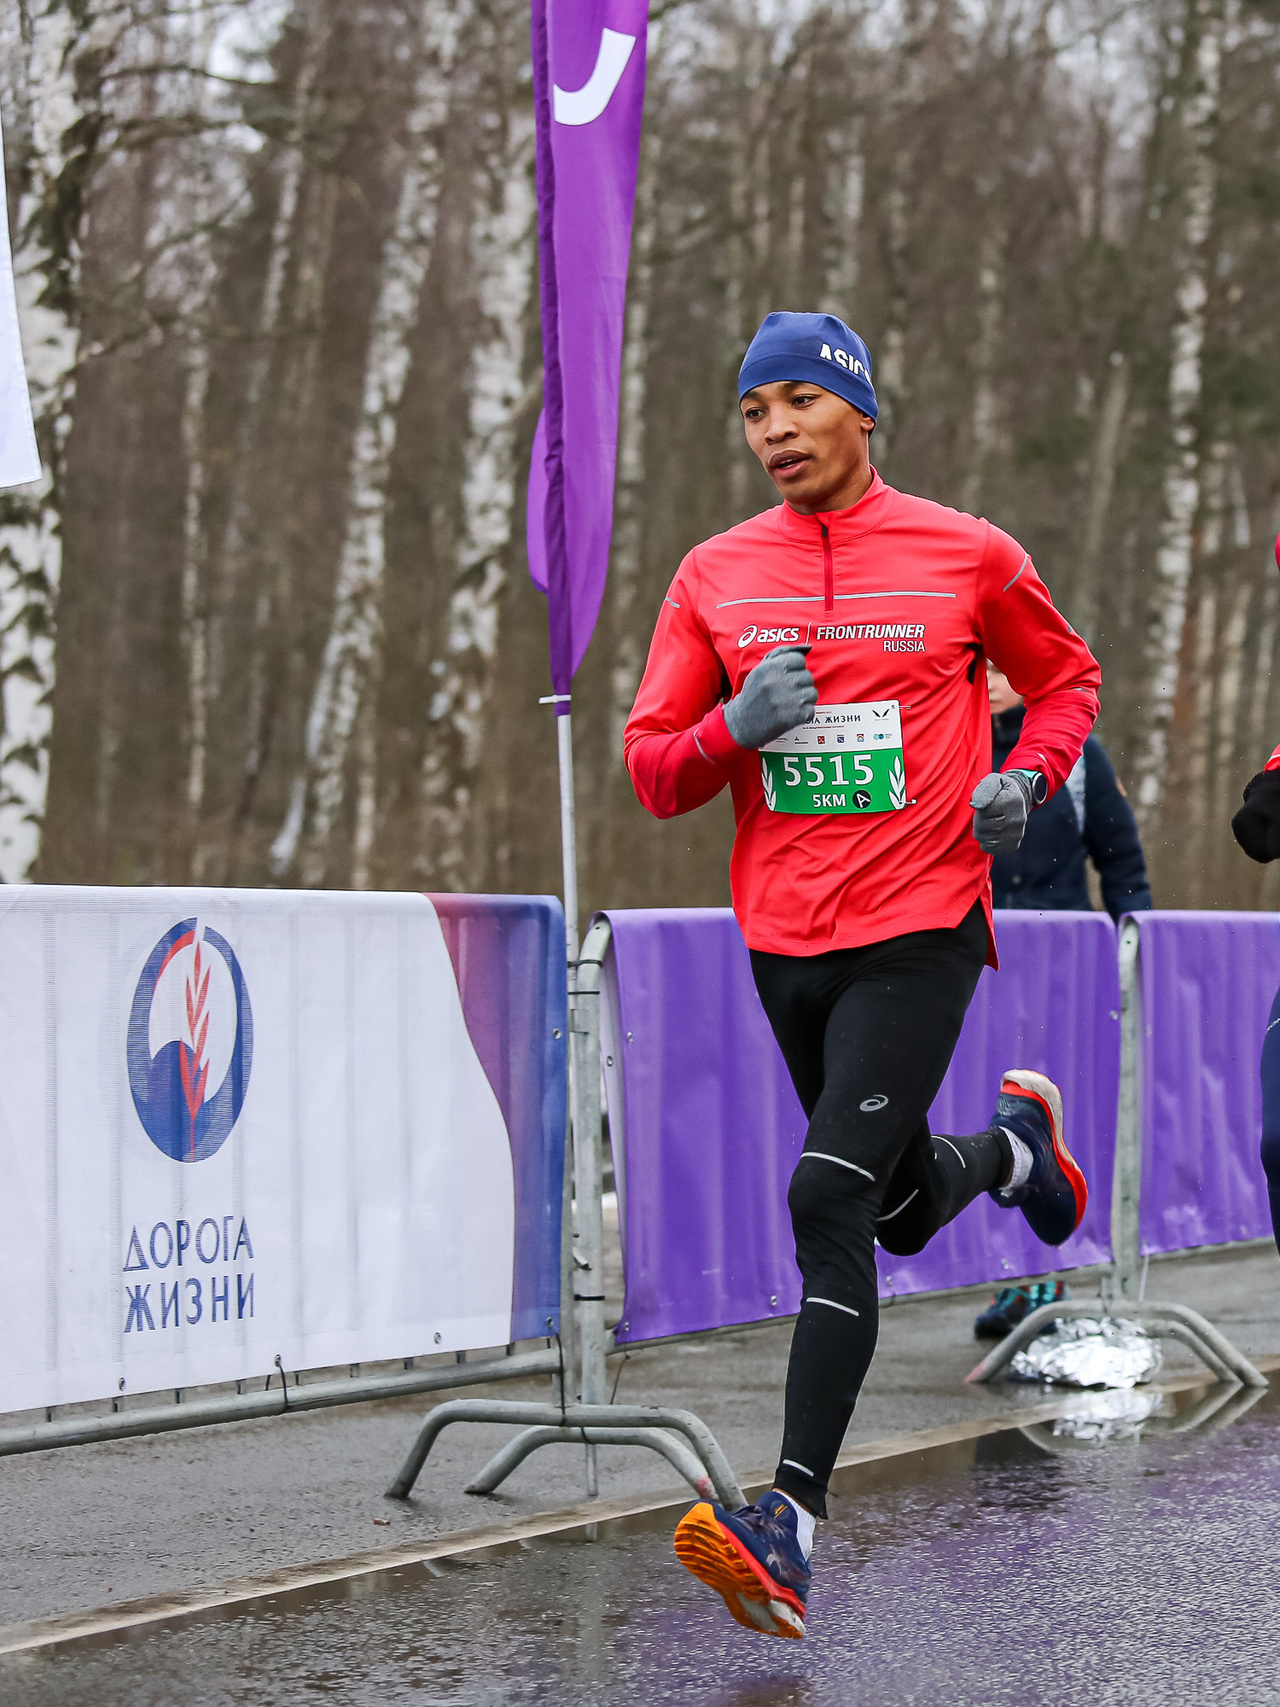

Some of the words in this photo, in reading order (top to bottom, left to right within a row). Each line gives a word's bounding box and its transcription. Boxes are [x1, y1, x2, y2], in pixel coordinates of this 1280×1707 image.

[816, 624, 926, 641] FRONTRUNNER
[883, 640, 926, 652] RUSSIA
[824, 714, 861, 724] ЖИЗНИ
[783, 754, 875, 787] 5515
[123, 1215, 254, 1272] ДОРОГА
[123, 1272, 255, 1334] ЖИЗНИ
